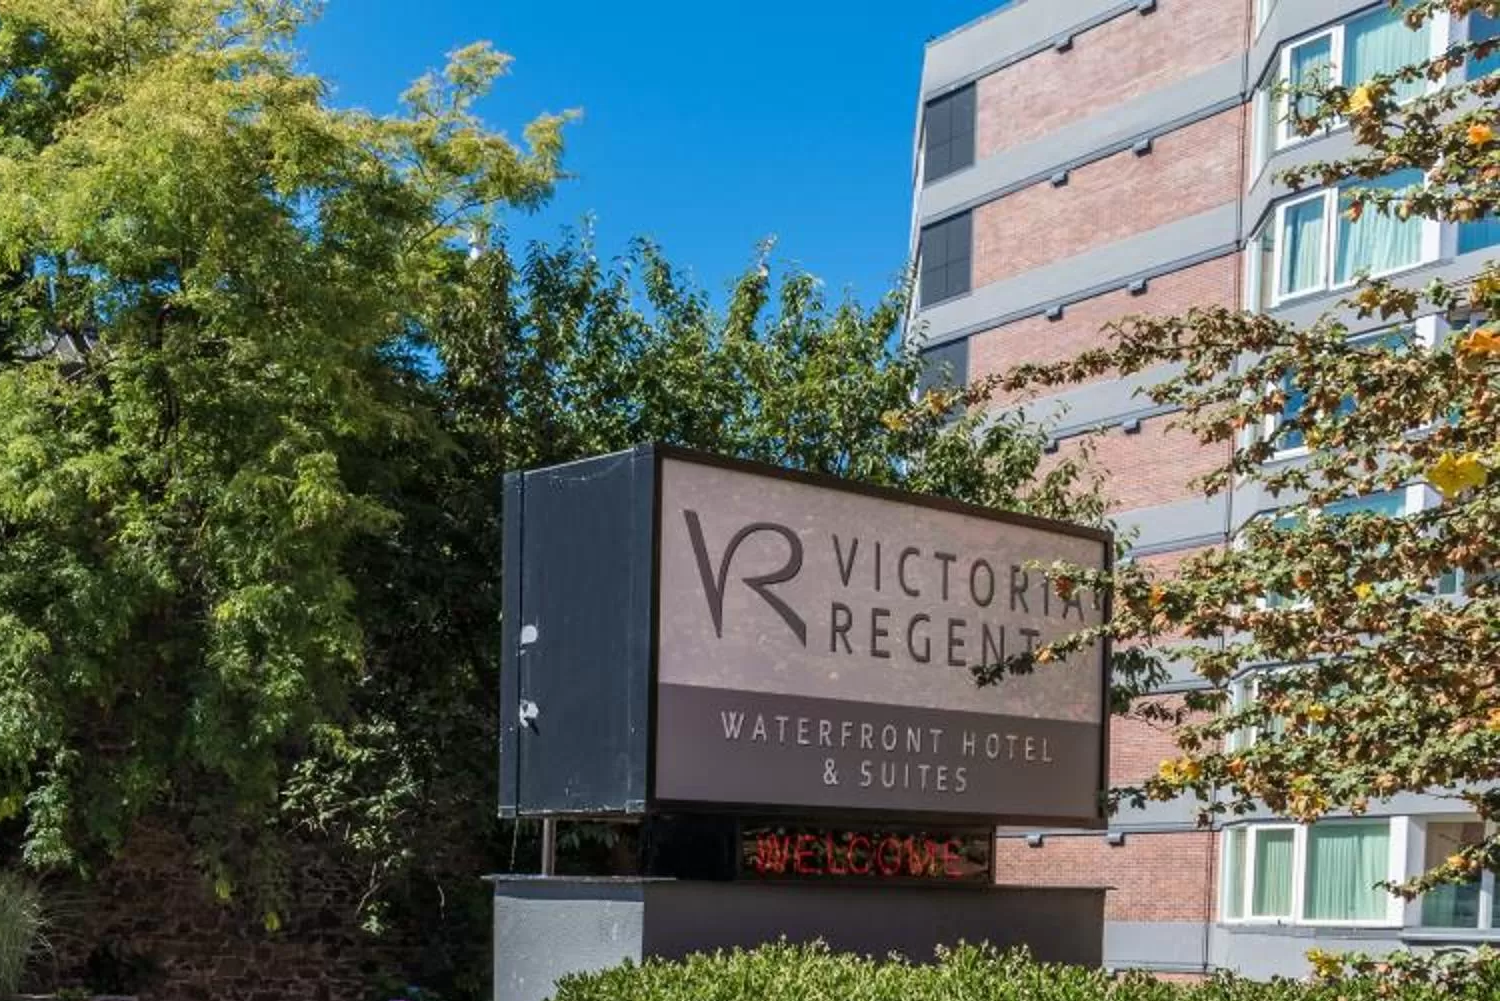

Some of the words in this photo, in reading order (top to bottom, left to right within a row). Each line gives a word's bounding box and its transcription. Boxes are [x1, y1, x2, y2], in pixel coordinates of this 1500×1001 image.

[832, 534, 1085, 624] VICTORIA
[830, 601, 1041, 668] REGENT
[720, 710, 944, 755] WATERFRONT
[962, 730, 1053, 764] HOTEL
[822, 757, 839, 786] &
[859, 759, 968, 794] SUITES
[756, 832, 965, 878] WELCOME
